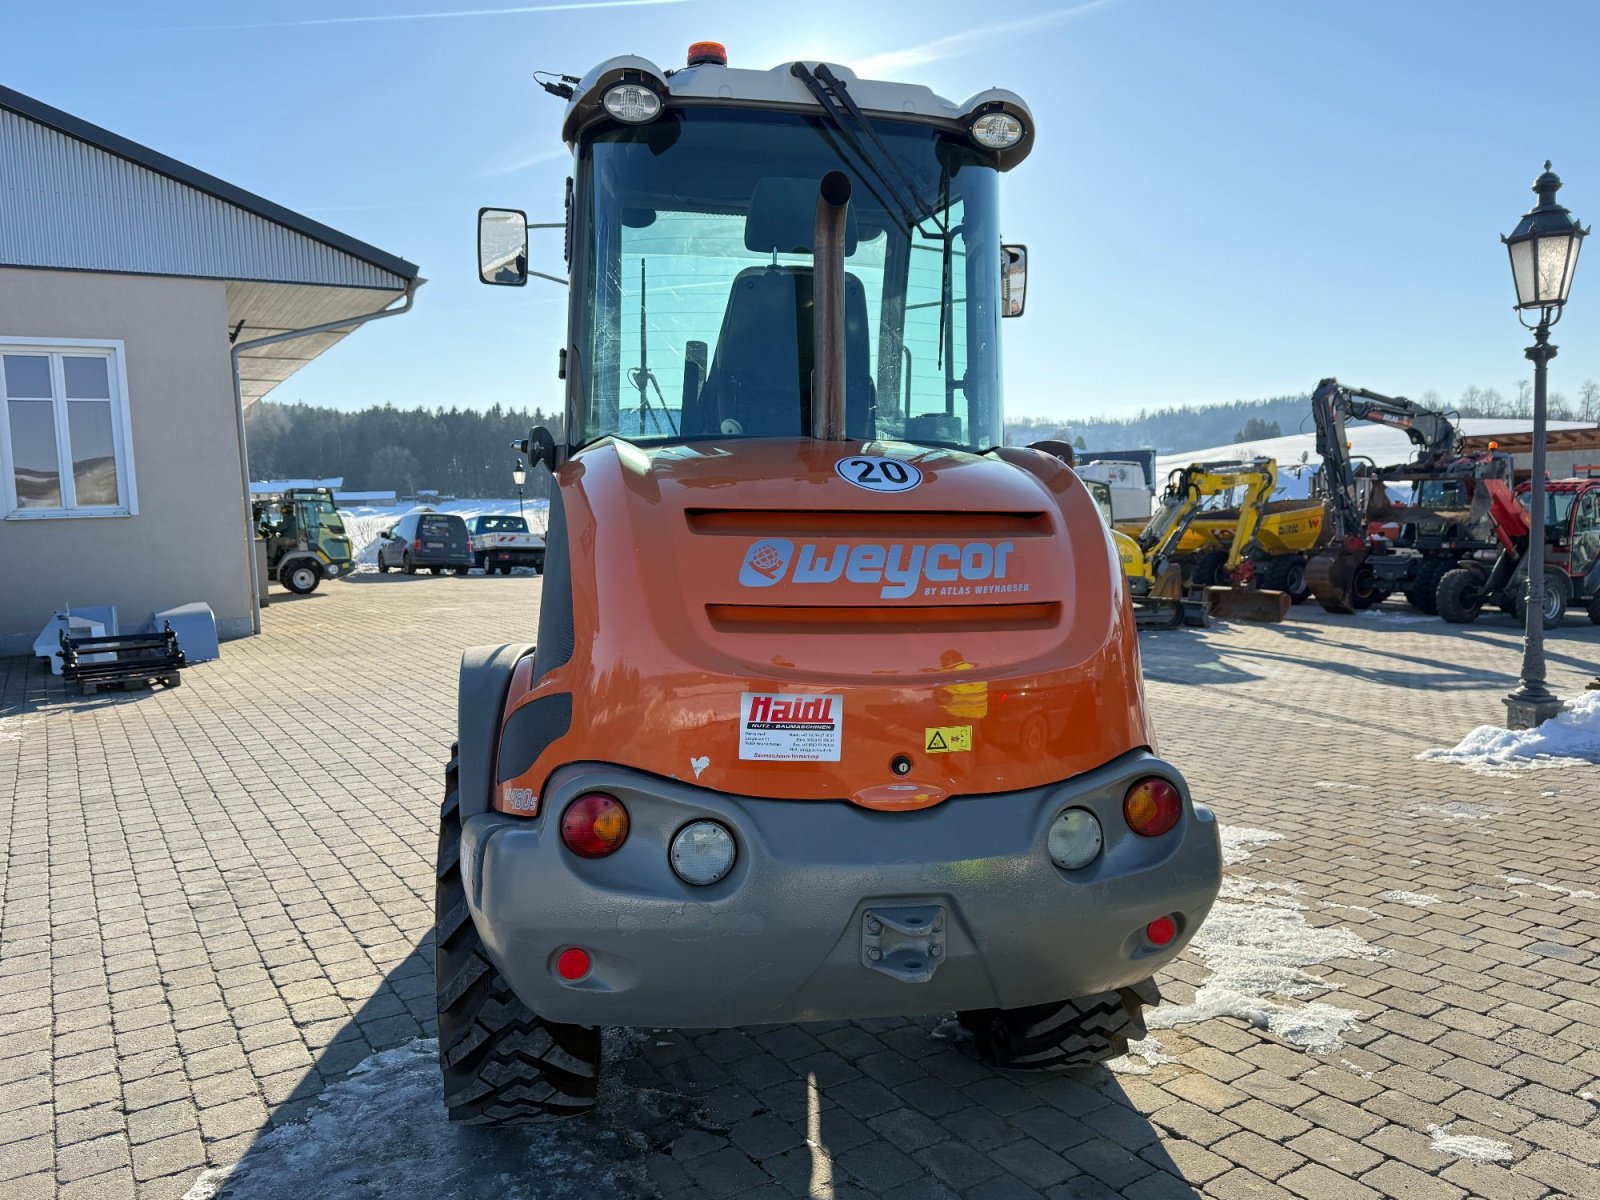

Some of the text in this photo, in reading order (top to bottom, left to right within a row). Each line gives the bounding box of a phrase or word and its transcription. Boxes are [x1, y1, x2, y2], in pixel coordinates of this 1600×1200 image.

[850, 460, 908, 484] 20
[792, 541, 1014, 599] weycor
[924, 583, 1030, 596] BY ATLAS WEYHAUSEN
[748, 696, 834, 723] Haidl
